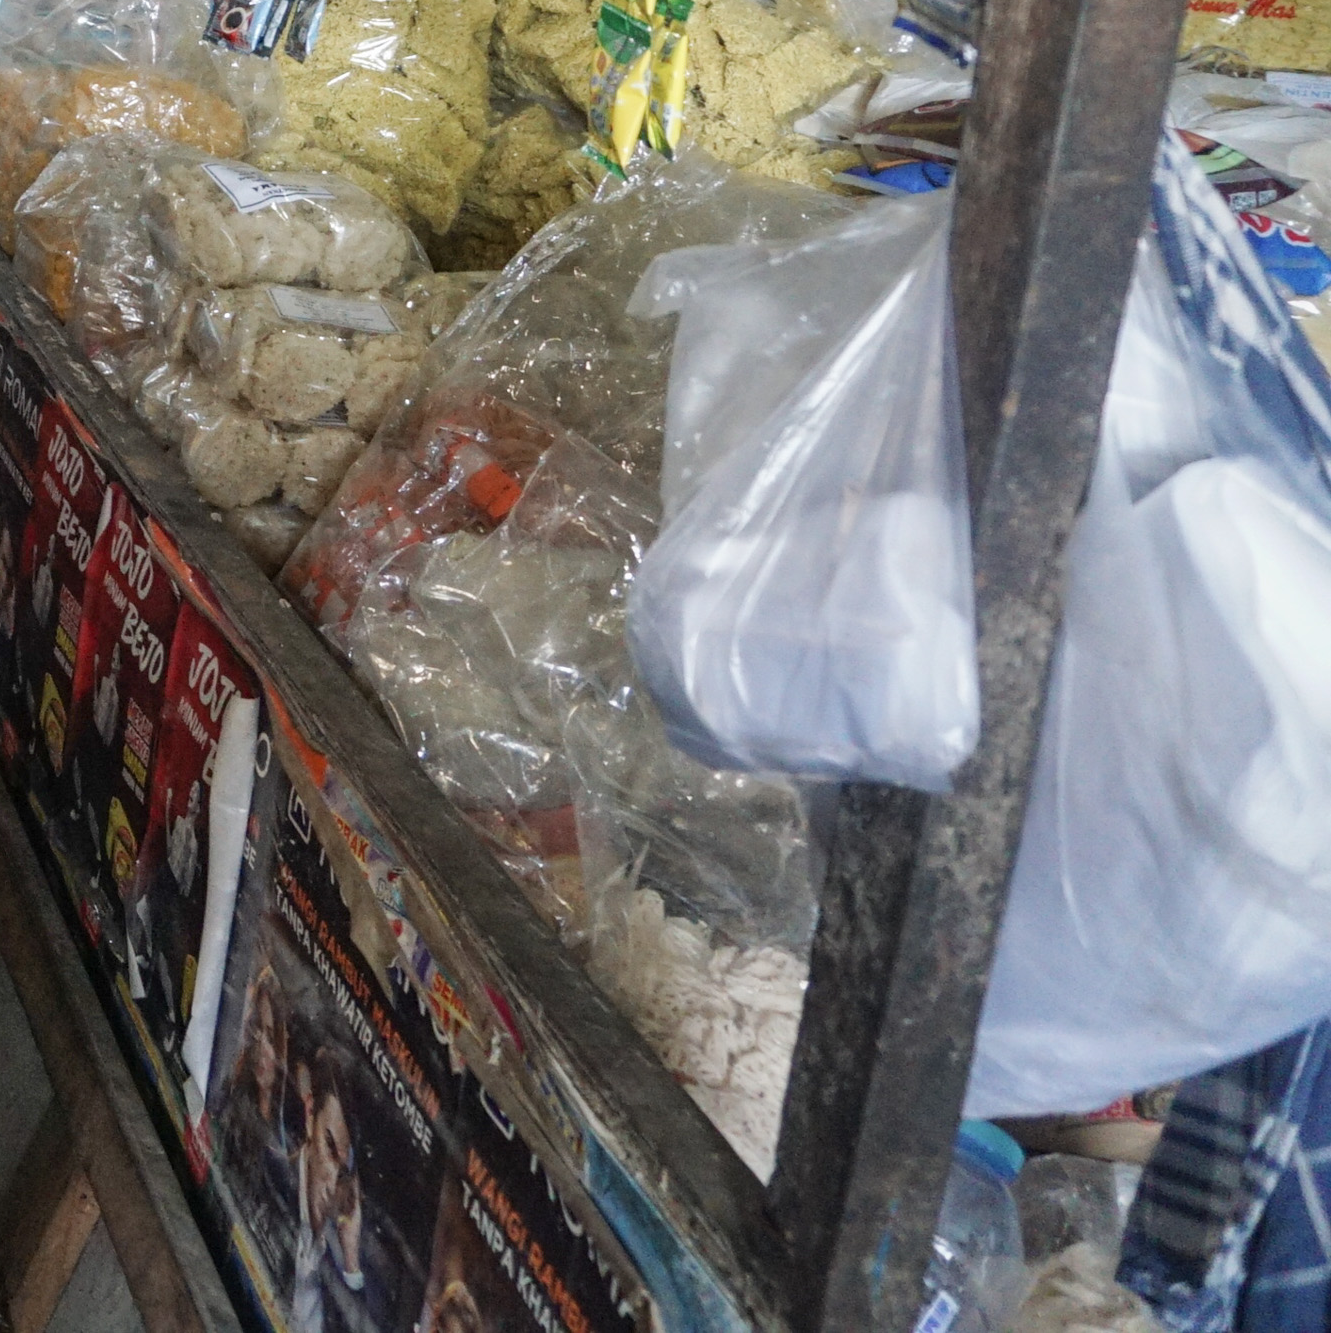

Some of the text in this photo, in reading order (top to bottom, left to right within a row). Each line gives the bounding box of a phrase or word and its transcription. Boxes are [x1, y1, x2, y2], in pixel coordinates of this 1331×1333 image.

[47, 424, 84, 497] JOJO
[56, 499, 92, 573] BEJO
[111, 519, 154, 601] JOJO
[121, 601, 165, 684] BEJO
[188, 642, 242, 723] JOJ
[177, 696, 209, 751] MINUM
[275, 886, 434, 1155] TANPA KHAWATIR KETOMBE
[461, 1179, 515, 1280] TANPA
